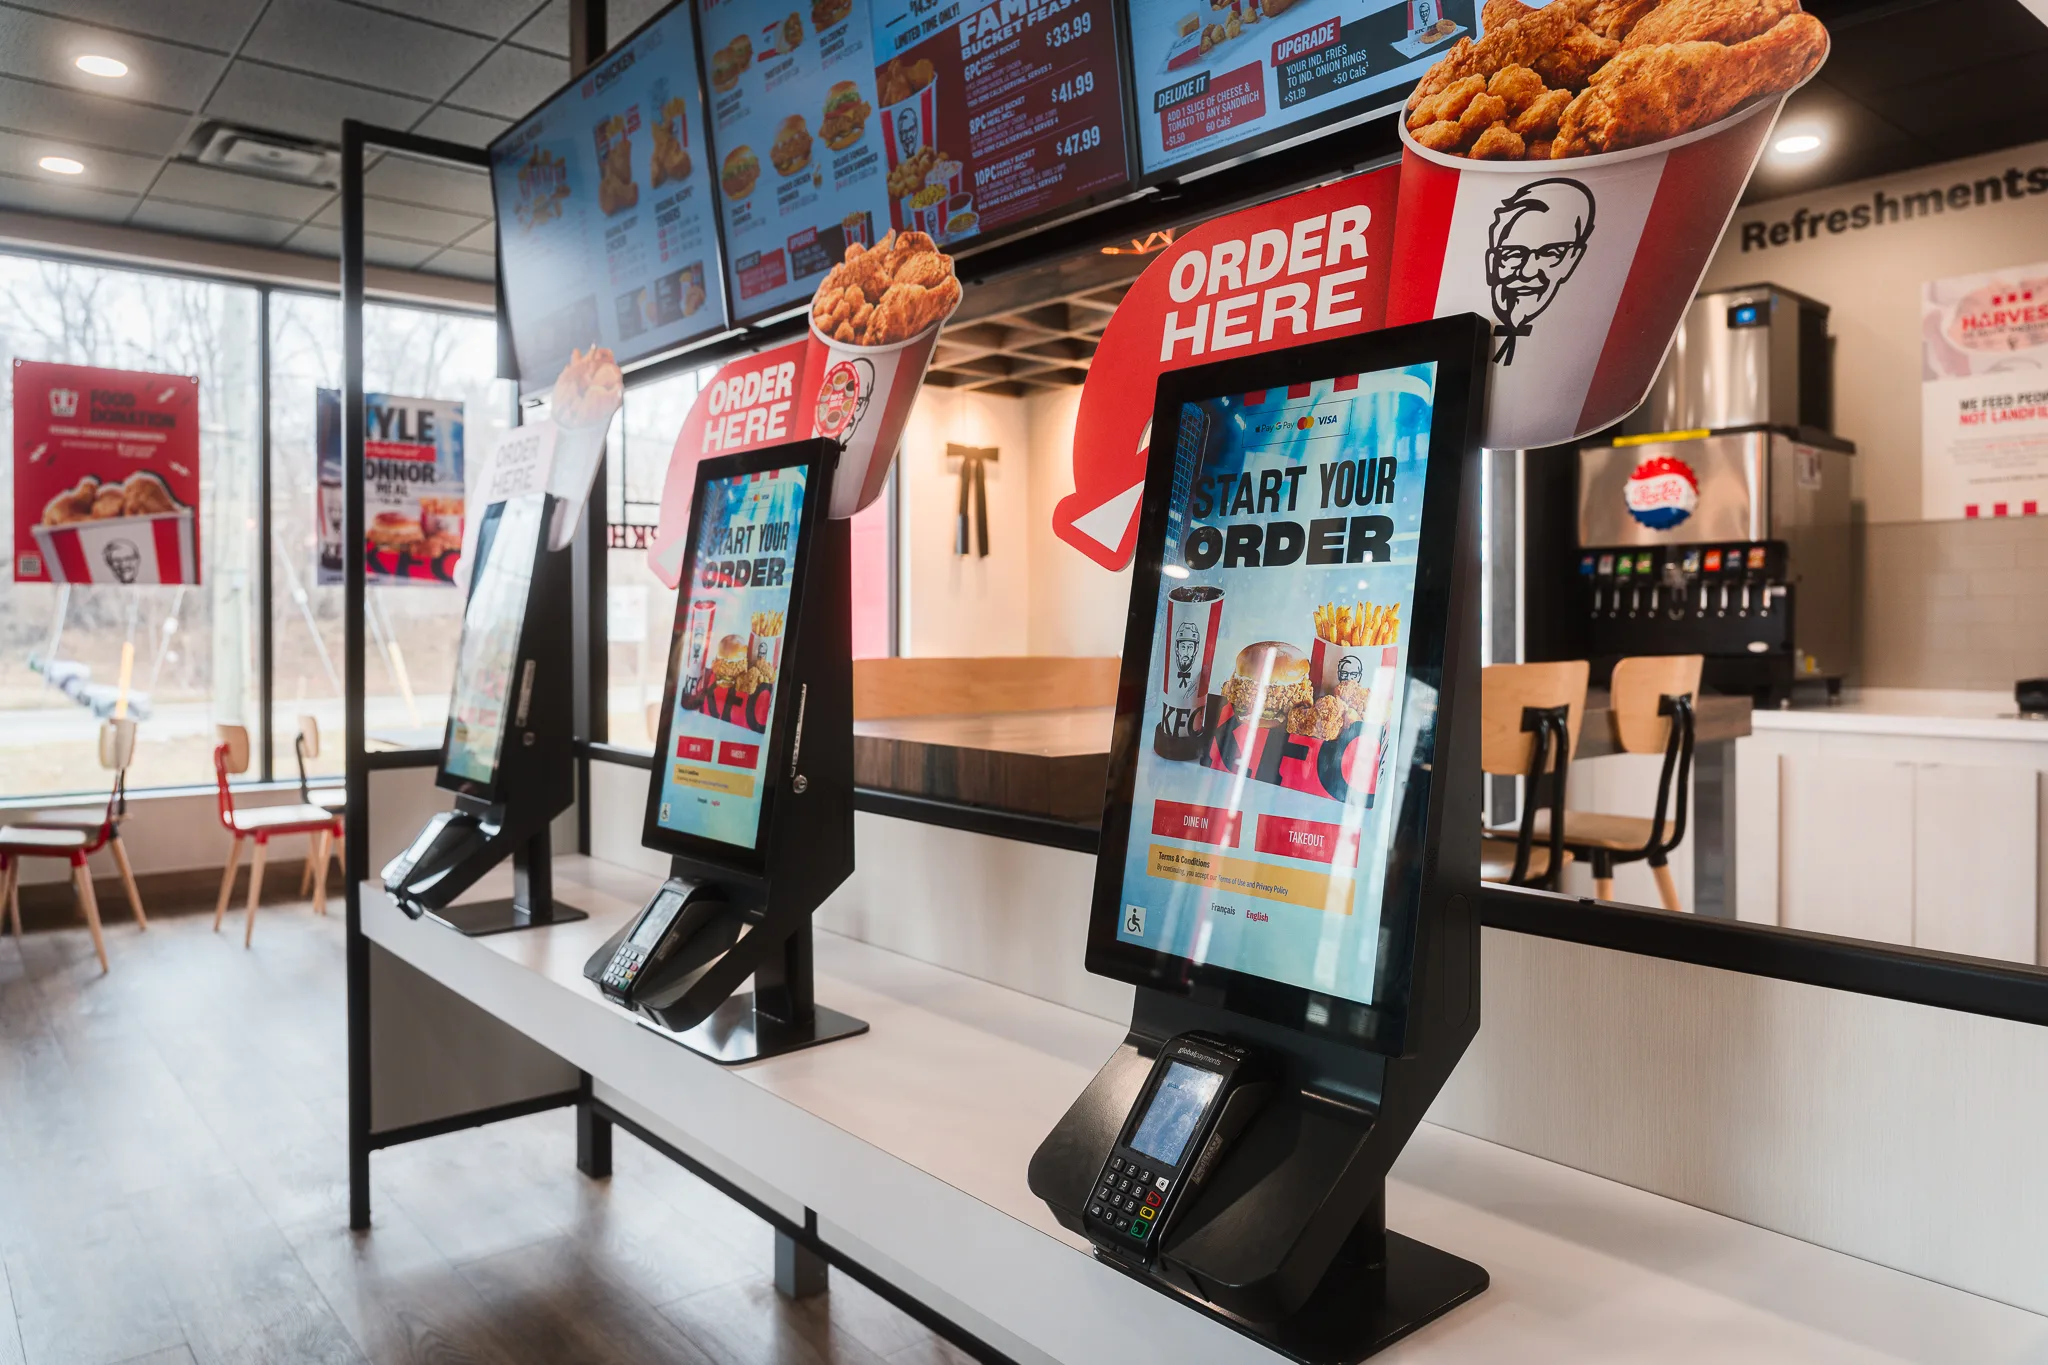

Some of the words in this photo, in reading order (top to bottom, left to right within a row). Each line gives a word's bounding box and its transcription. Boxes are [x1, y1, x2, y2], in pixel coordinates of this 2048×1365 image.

[961, 18, 1024, 60] BUCKET
[1027, 0, 1080, 27] FEAS
[1046, 12, 1092, 48] $33.99
[1277, 22, 1335, 62] UPGRADE
[964, 61, 982, 82] 6PC
[1286, 55, 1308, 77] YOUR
[1310, 51, 1324, 71] IND.
[1325, 44, 1348, 66] FRIES
[1287, 74, 1298, 88] TO
[1299, 68, 1315, 85] IND.
[1316, 59, 1340, 79] ONION
[1342, 50, 1367, 72] RINGS
[1051, 71, 1094, 104] $41.99
[1158, 81, 1195, 109] DELUXE
[1196, 77, 1206, 94] IT
[1333, 71, 1348, 85] +50
[1167, 110, 1181, 123] ADD
[1187, 101, 1205, 115] SLICE
[1206, 95, 1216, 108] OF
[1217, 87, 1243, 107] CHEESE
[1244, 84, 1250, 94] &
[1284, 87, 1306, 103] +$1.19
[969, 115, 987, 135] 8PC
[1168, 115, 1194, 133] TOMATO
[1195, 113, 1205, 123] TO
[1206, 107, 1220, 120] ANY
[1221, 90, 1260, 113] SANDWICH
[1206, 121, 1215, 133] 60
[1056, 125, 1101, 157] $47.99
[974, 164, 998, 187] 10PC
[1741, 165, 2048, 252] Refreshments
[1169, 205, 1372, 303] ORDER
[1160, 266, 1367, 362] HERE
[89, 388, 136, 407] FOOD
[708, 361, 796, 416] ORDER
[89, 408, 177, 429] DONATION
[701, 401, 791, 453] HERE
[1261, 424, 1275, 433] Pay
[1283, 421, 1295, 430] Pay
[1318, 414, 1337, 426] VISA
[1959, 412, 1987, 426] NOT
[496, 435, 541, 468] ORDER
[366, 459, 437, 484] ONNOR
[489, 464, 536, 497] HERE
[1192, 465, 1307, 519] START
[1320, 456, 1397, 509] YOUR
[708, 525, 755, 558] START
[758, 521, 790, 553] YOUR
[1185, 515, 1395, 571] ORDER
[701, 557, 786, 590] ORDER
[1161, 701, 1206, 739] KFC
[1199, 692, 1376, 810] KFC
[1183, 814, 1200, 828] DINE
[1201, 817, 1209, 829] IN
[1288, 830, 1325, 848] TAKEOUT
[1158, 851, 1175, 863] Terms
[1175, 855, 1180, 863] &
[1180, 855, 1210, 869] Conditions
[1156, 864, 1162, 872] By
[1186, 870, 1194, 878] you
[1195, 871, 1209, 880] accept
[1218, 874, 1230, 884] Terms
[1231, 876, 1237, 885] of
[1237, 878, 1246, 887] Use
[1246, 880, 1255, 889] and
[1256, 882, 1273, 894] Privacy
[1273, 885, 1289, 896] Policy
[1211, 903, 1236, 916] Français
[1246, 910, 1269, 923] English
[1177, 1047, 1222, 1066] globalpayments
[1108, 1173, 1115, 1181] 4
[1135, 1186, 1142, 1194] 6
[1128, 1165, 1136, 1173] 2
[1143, 1171, 1150, 1179] 3
[1127, 1201, 1134, 1209] 9
